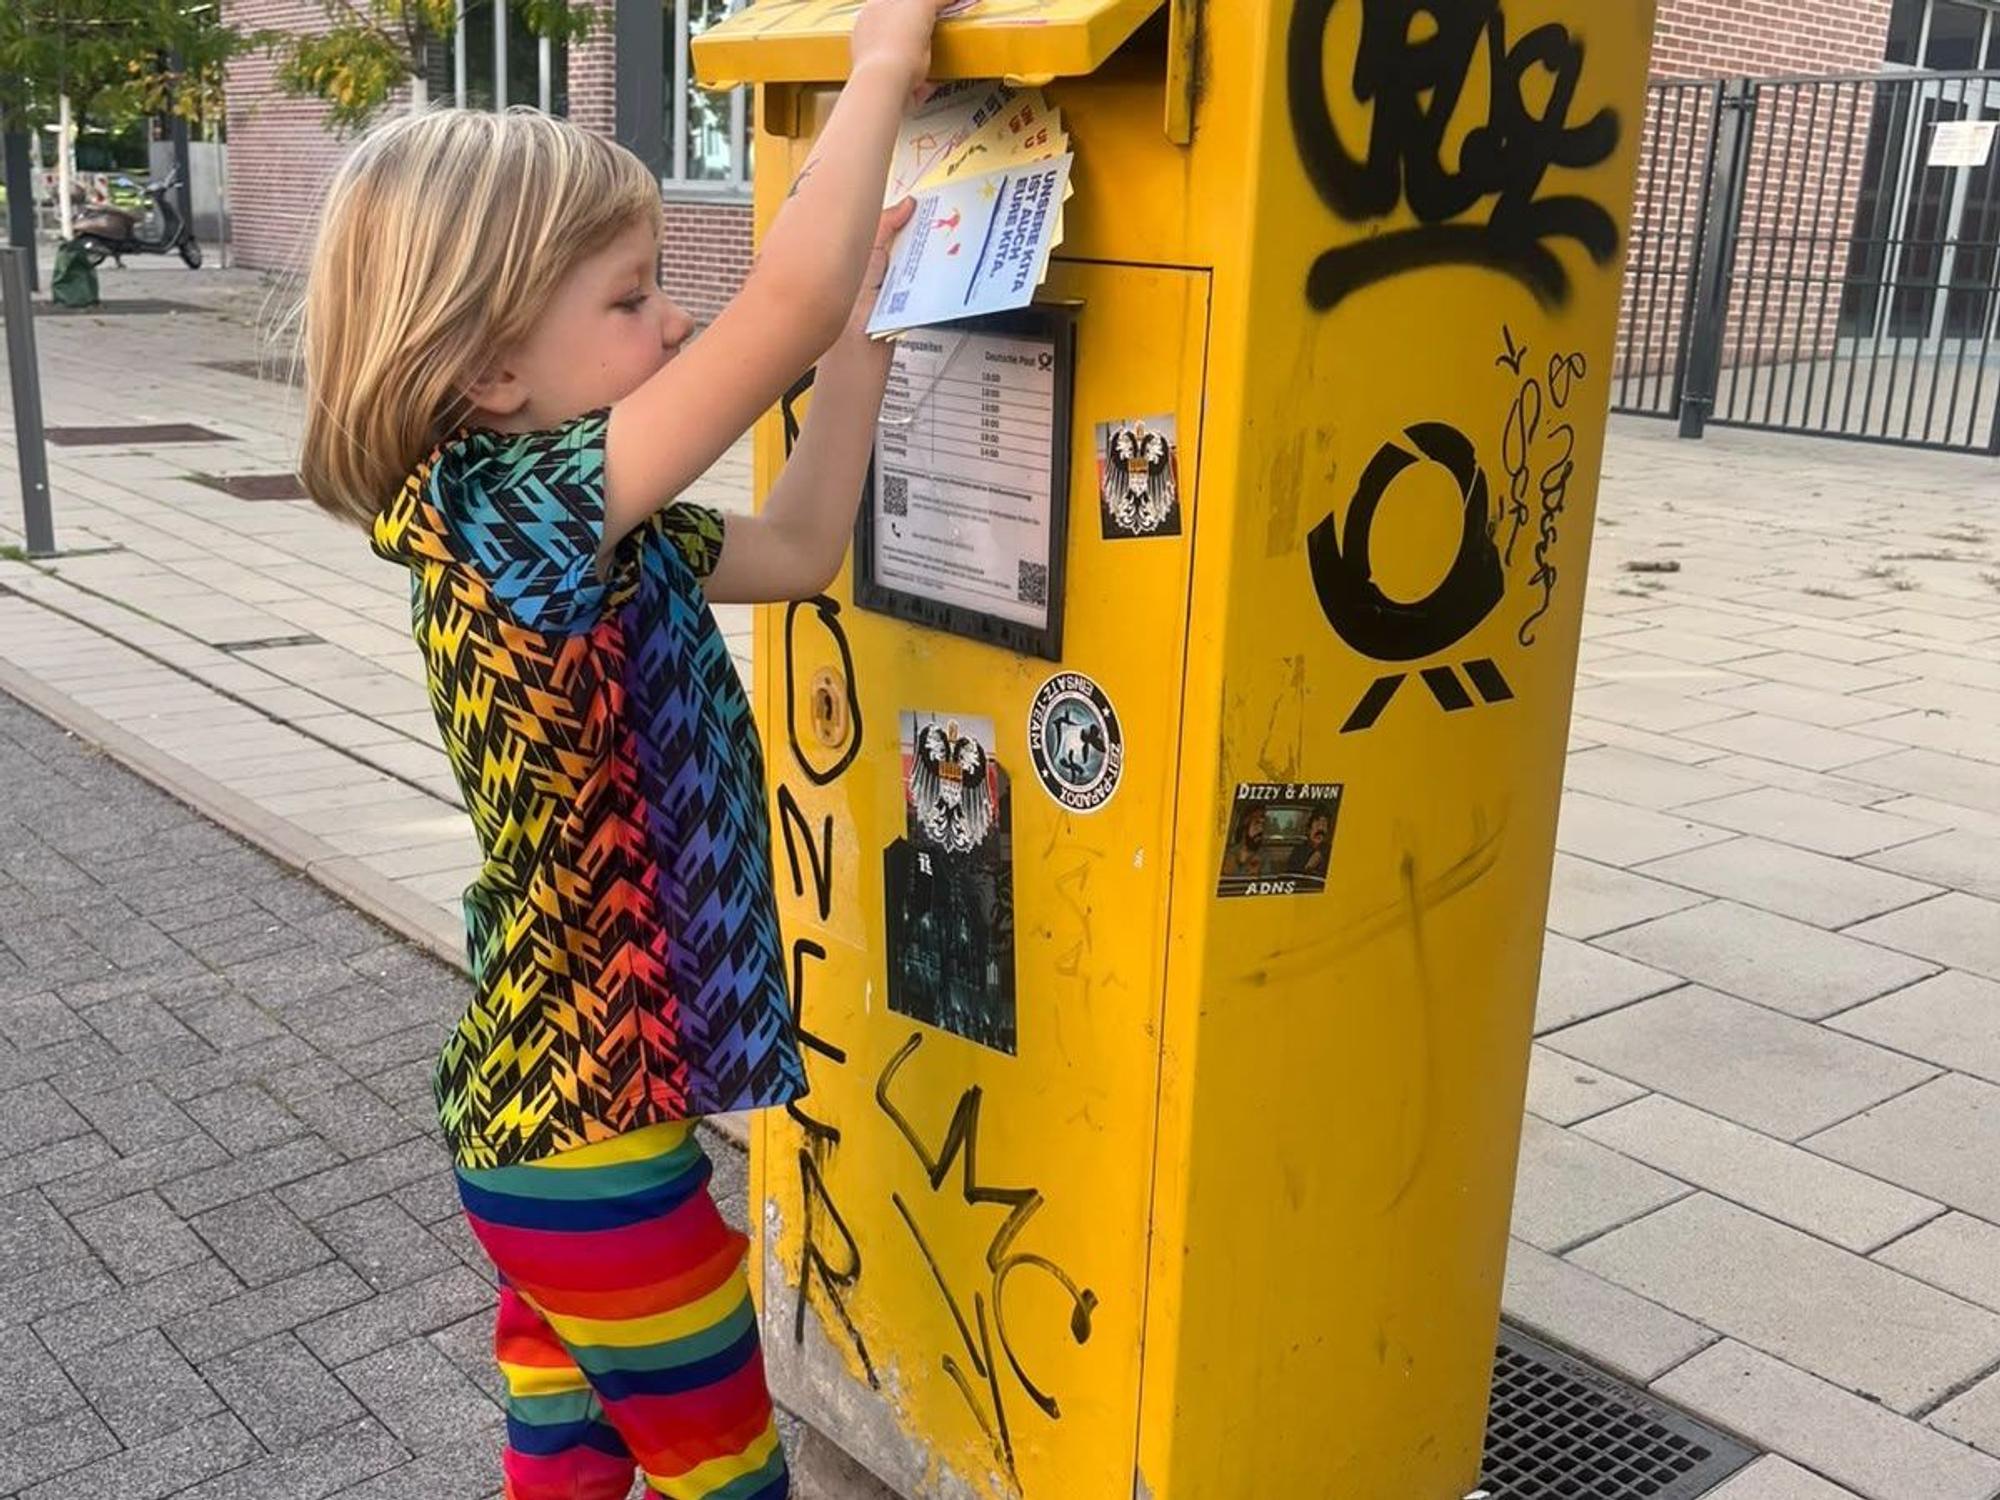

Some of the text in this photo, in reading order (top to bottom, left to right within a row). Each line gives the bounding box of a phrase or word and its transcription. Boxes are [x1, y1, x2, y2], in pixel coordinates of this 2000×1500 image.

[1005, 177, 1028, 227] EURE
[1008, 174, 1042, 260] IST AUCH
[1026, 170, 1057, 246] UNSERE
[1011, 249, 1035, 292] KITA
[985, 351, 1036, 367] Deutsche Post
[1031, 675, 1094, 750] EINSATZ-TEAM
[1060, 742, 1121, 808] ZEIT-PARADOX
[1237, 783, 1281, 800] DIZZY
[1285, 784, 1297, 799] &
[1245, 881, 1296, 895] ADNS
